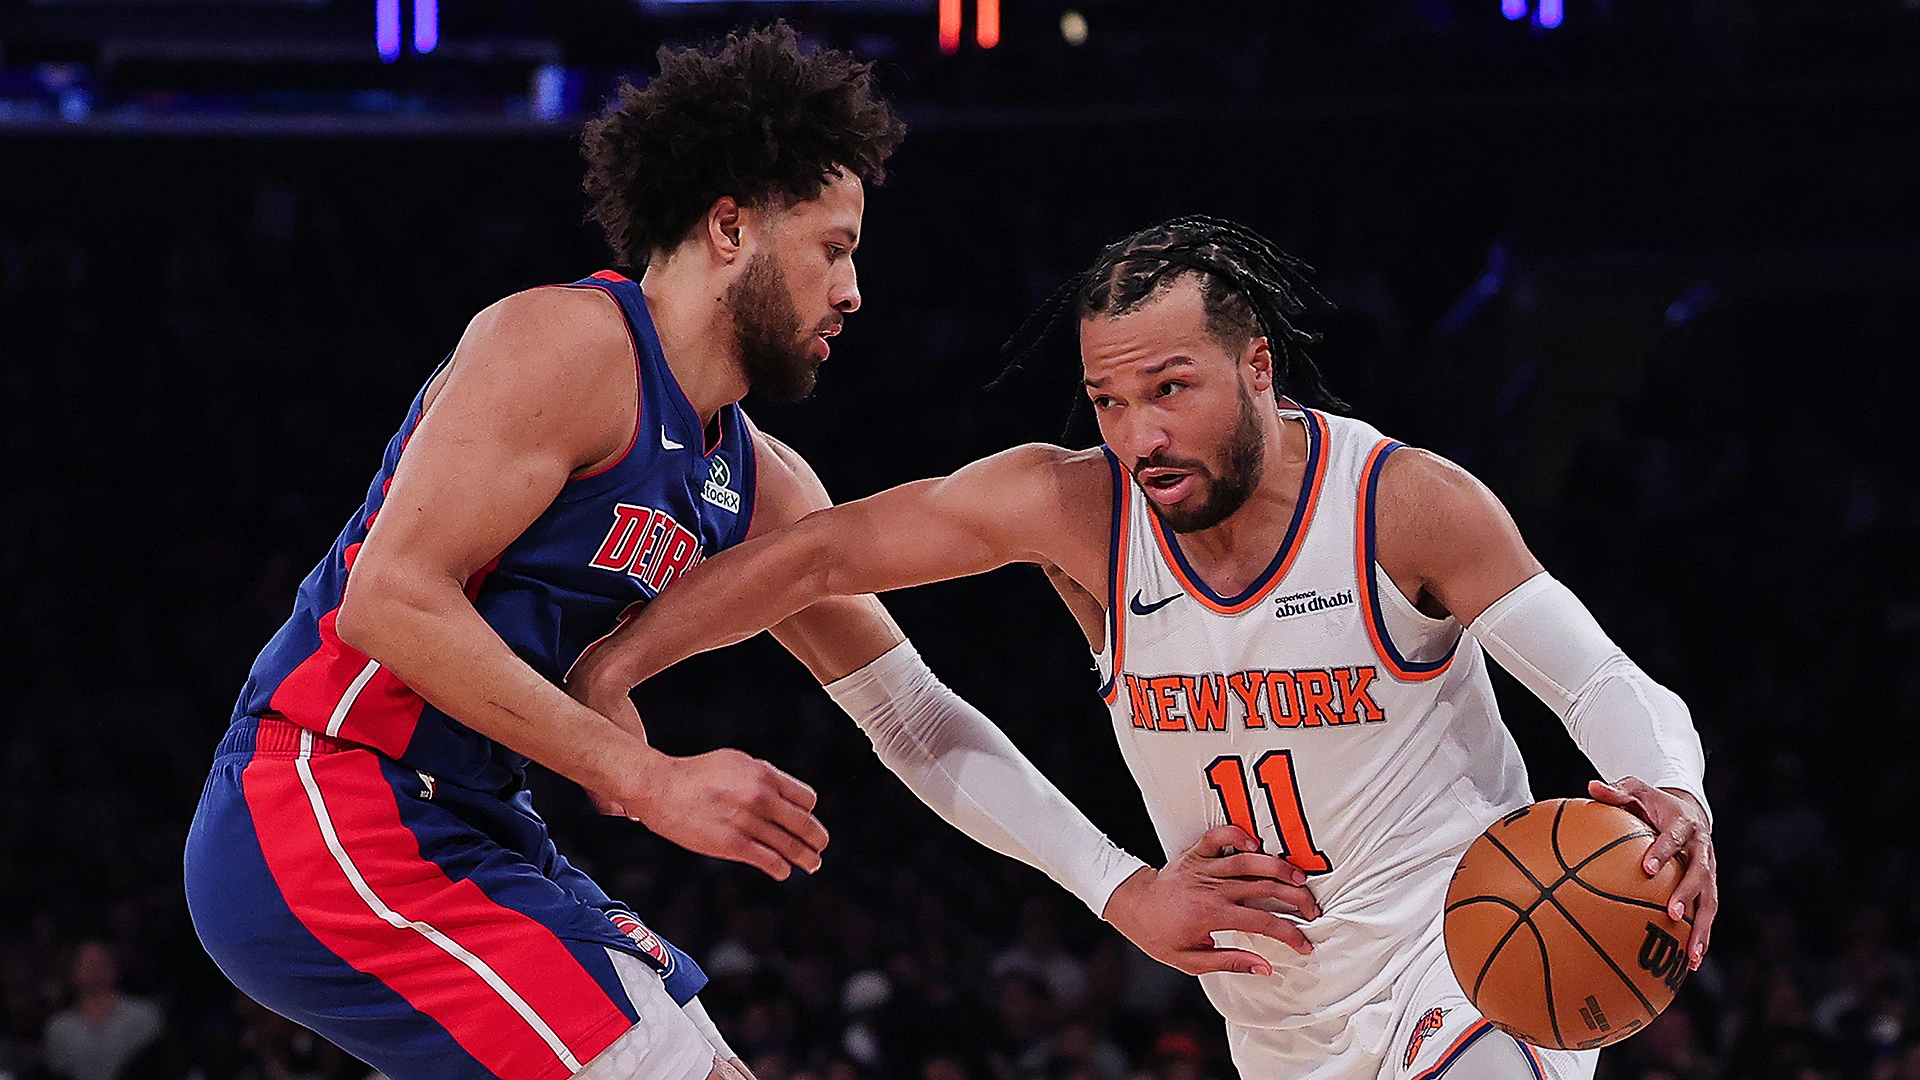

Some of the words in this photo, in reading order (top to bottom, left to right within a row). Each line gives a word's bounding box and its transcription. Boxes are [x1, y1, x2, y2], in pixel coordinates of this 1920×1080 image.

[703, 484, 738, 510] tockX
[1275, 591, 1316, 604] experience
[1275, 603, 1307, 618] abu
[1308, 589, 1353, 612] dhabi
[1125, 673, 1229, 732] NEW
[1229, 665, 1387, 730] YORK
[1204, 748, 1334, 876] 11
